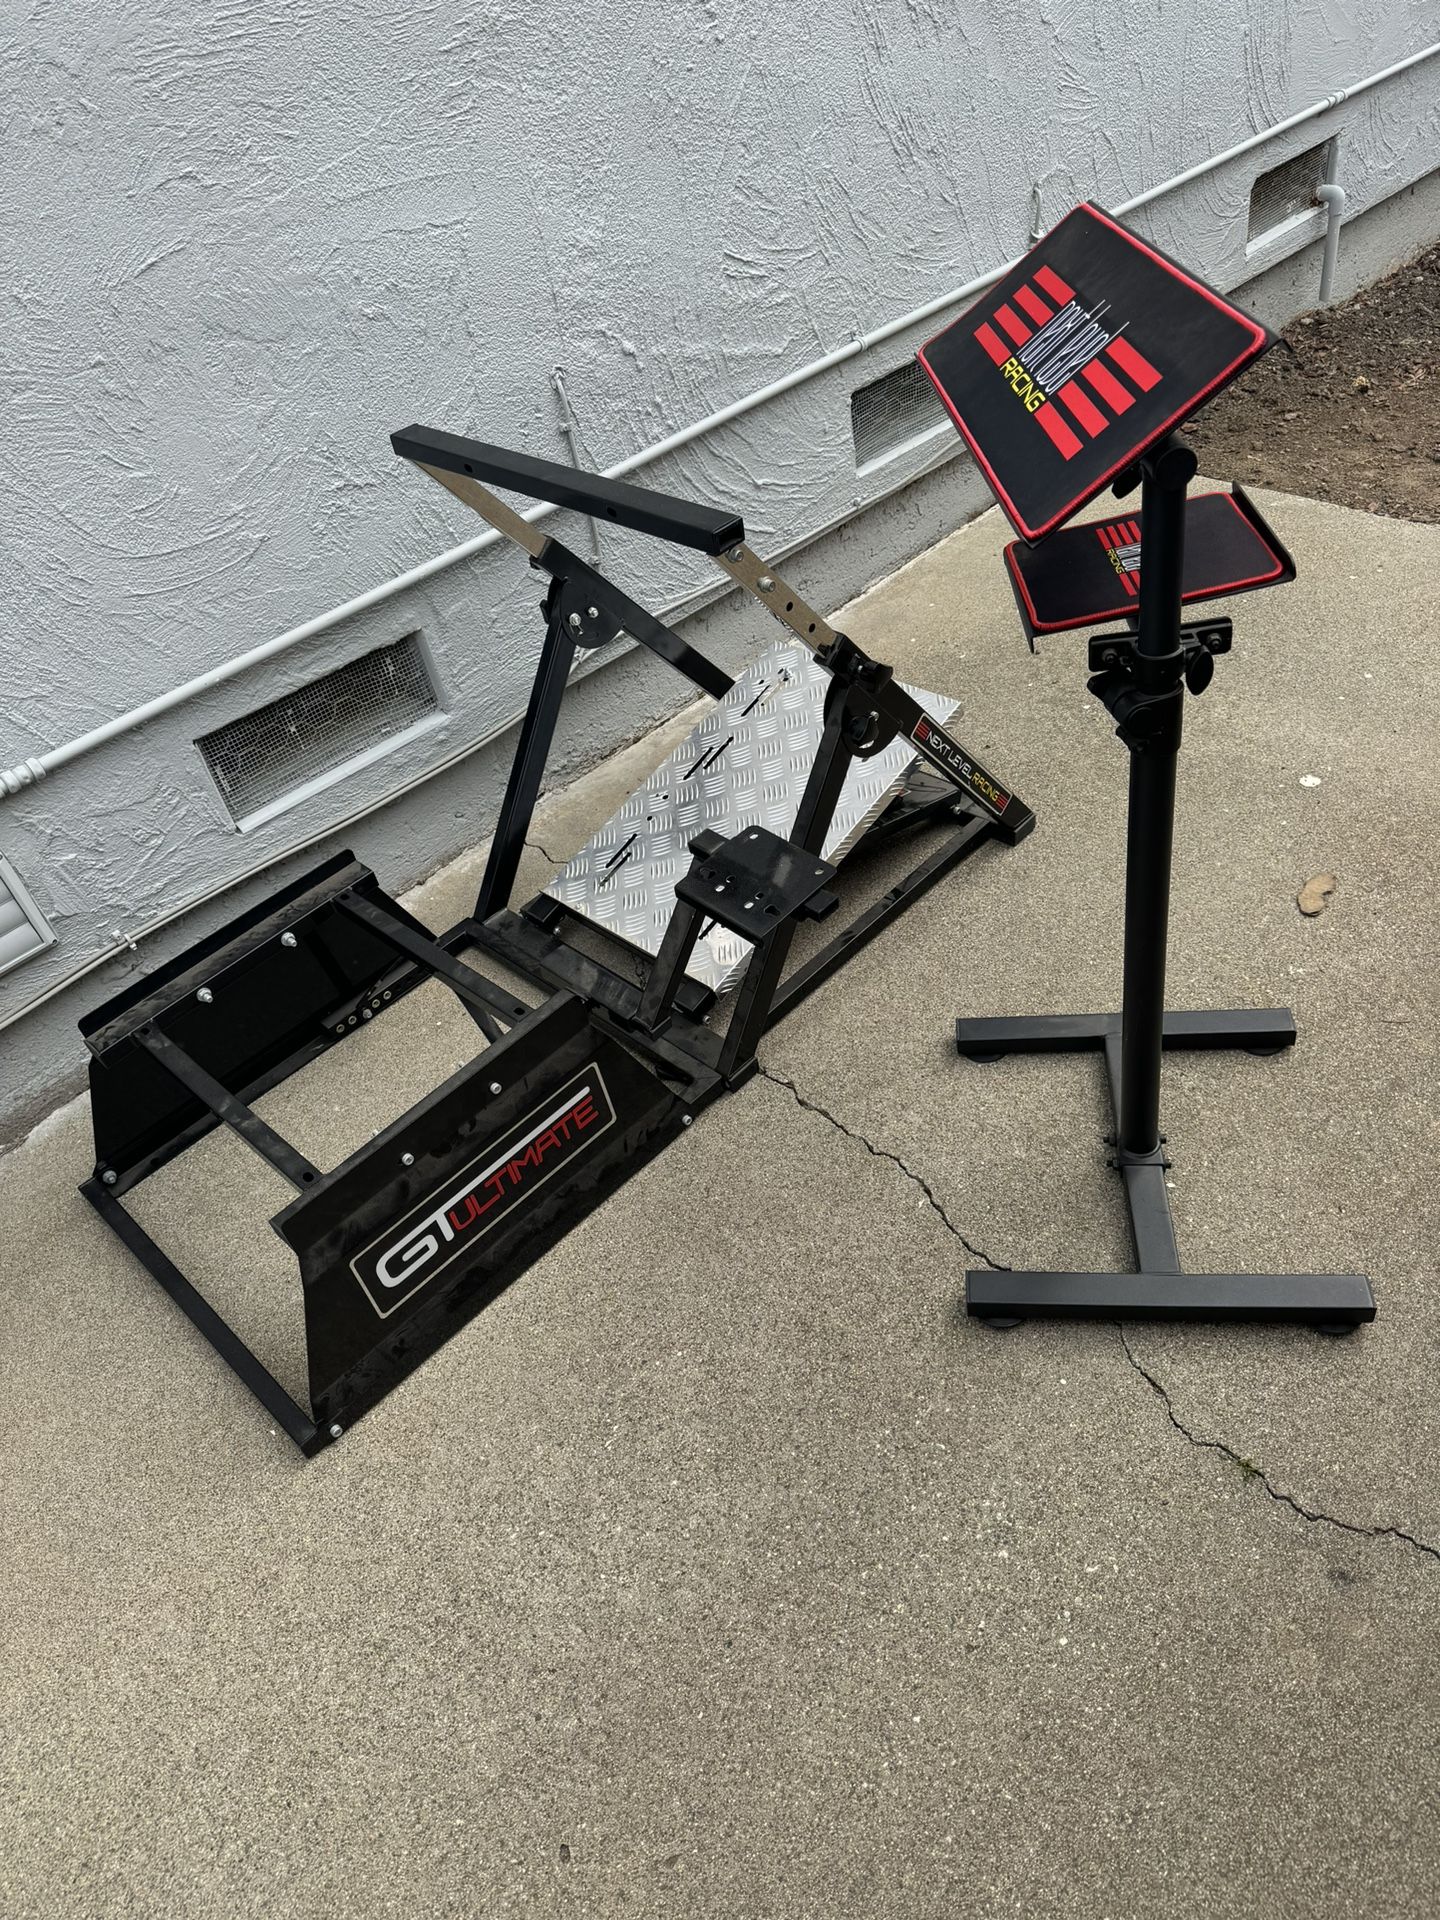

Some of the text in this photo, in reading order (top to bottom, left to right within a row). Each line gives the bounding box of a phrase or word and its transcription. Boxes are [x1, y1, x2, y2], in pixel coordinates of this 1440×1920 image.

[1016, 299, 1130, 396] next level
[1000, 357, 1046, 412] RACING
[1105, 548, 1125, 574] RACING
[926, 731, 999, 801] NEXT LEVEL RACING
[449, 1095, 599, 1231] ULTIMATE
